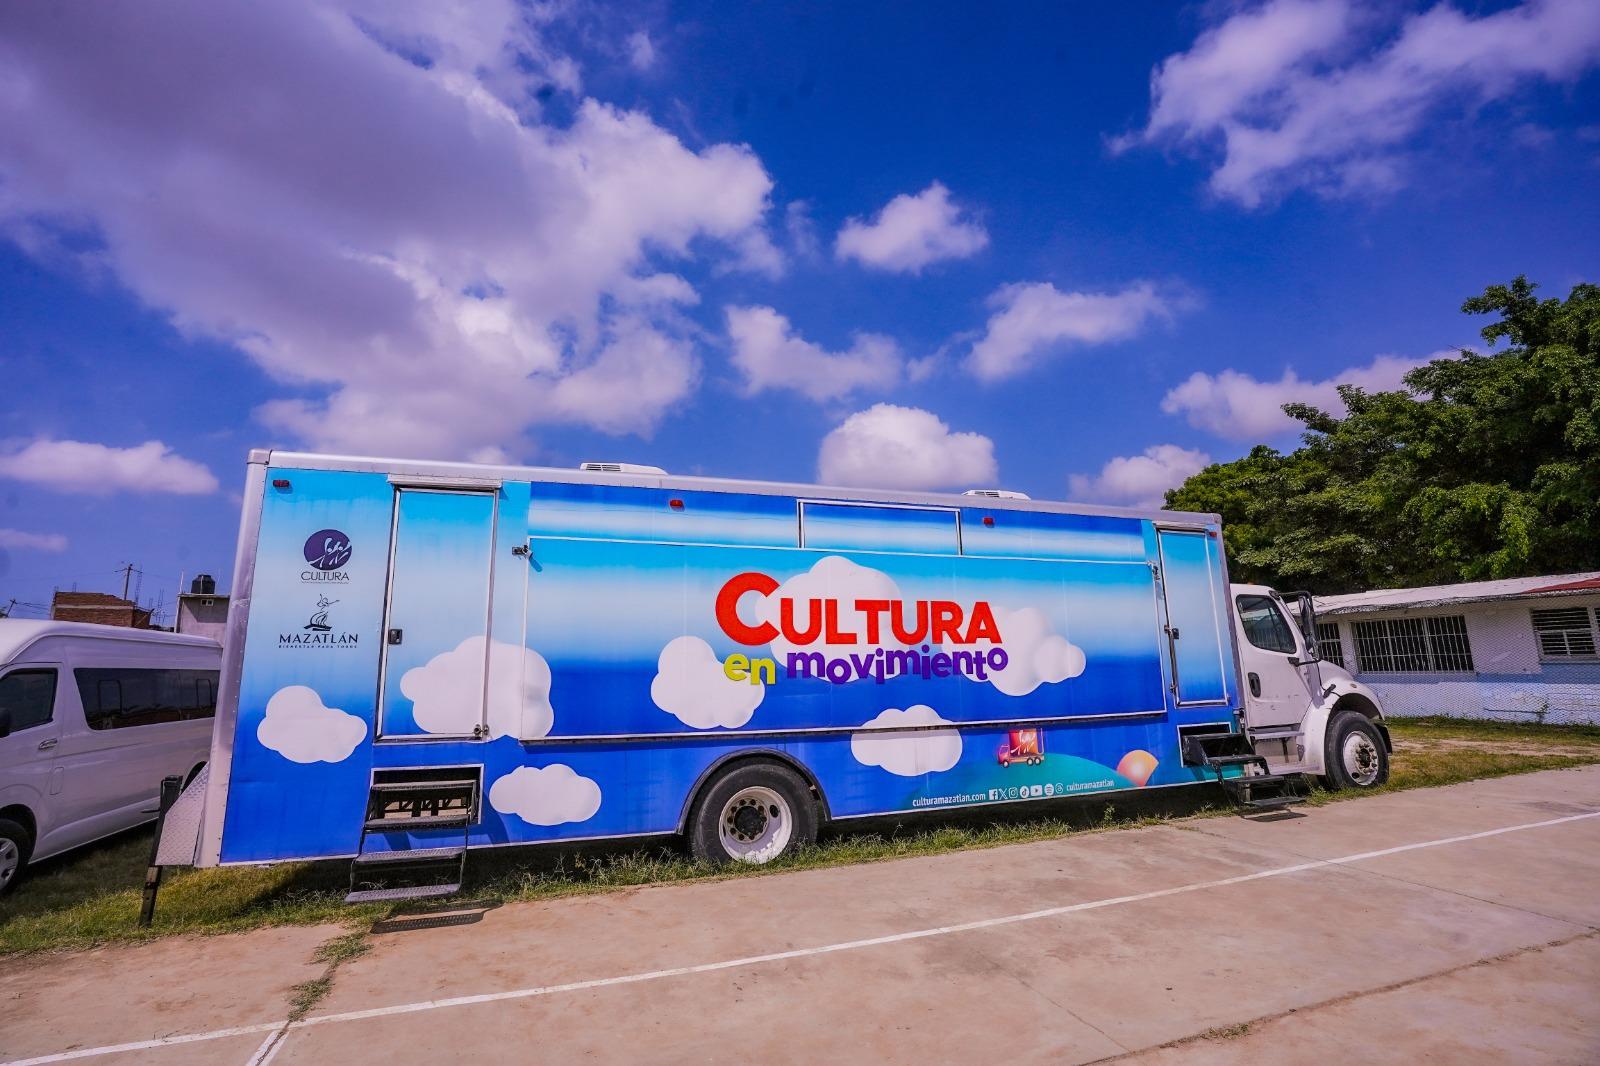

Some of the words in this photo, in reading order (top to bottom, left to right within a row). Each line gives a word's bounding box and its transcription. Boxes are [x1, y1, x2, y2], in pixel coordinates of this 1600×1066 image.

[301, 571, 350, 581] CULTURA
[715, 572, 1002, 646] CULTURA
[279, 632, 359, 644] MAZATLÁN
[723, 653, 776, 685] en
[787, 644, 1009, 685] movimiento
[1066, 778, 1115, 792] culturamazatlan
[912, 793, 986, 807] culturamazatlan.com
